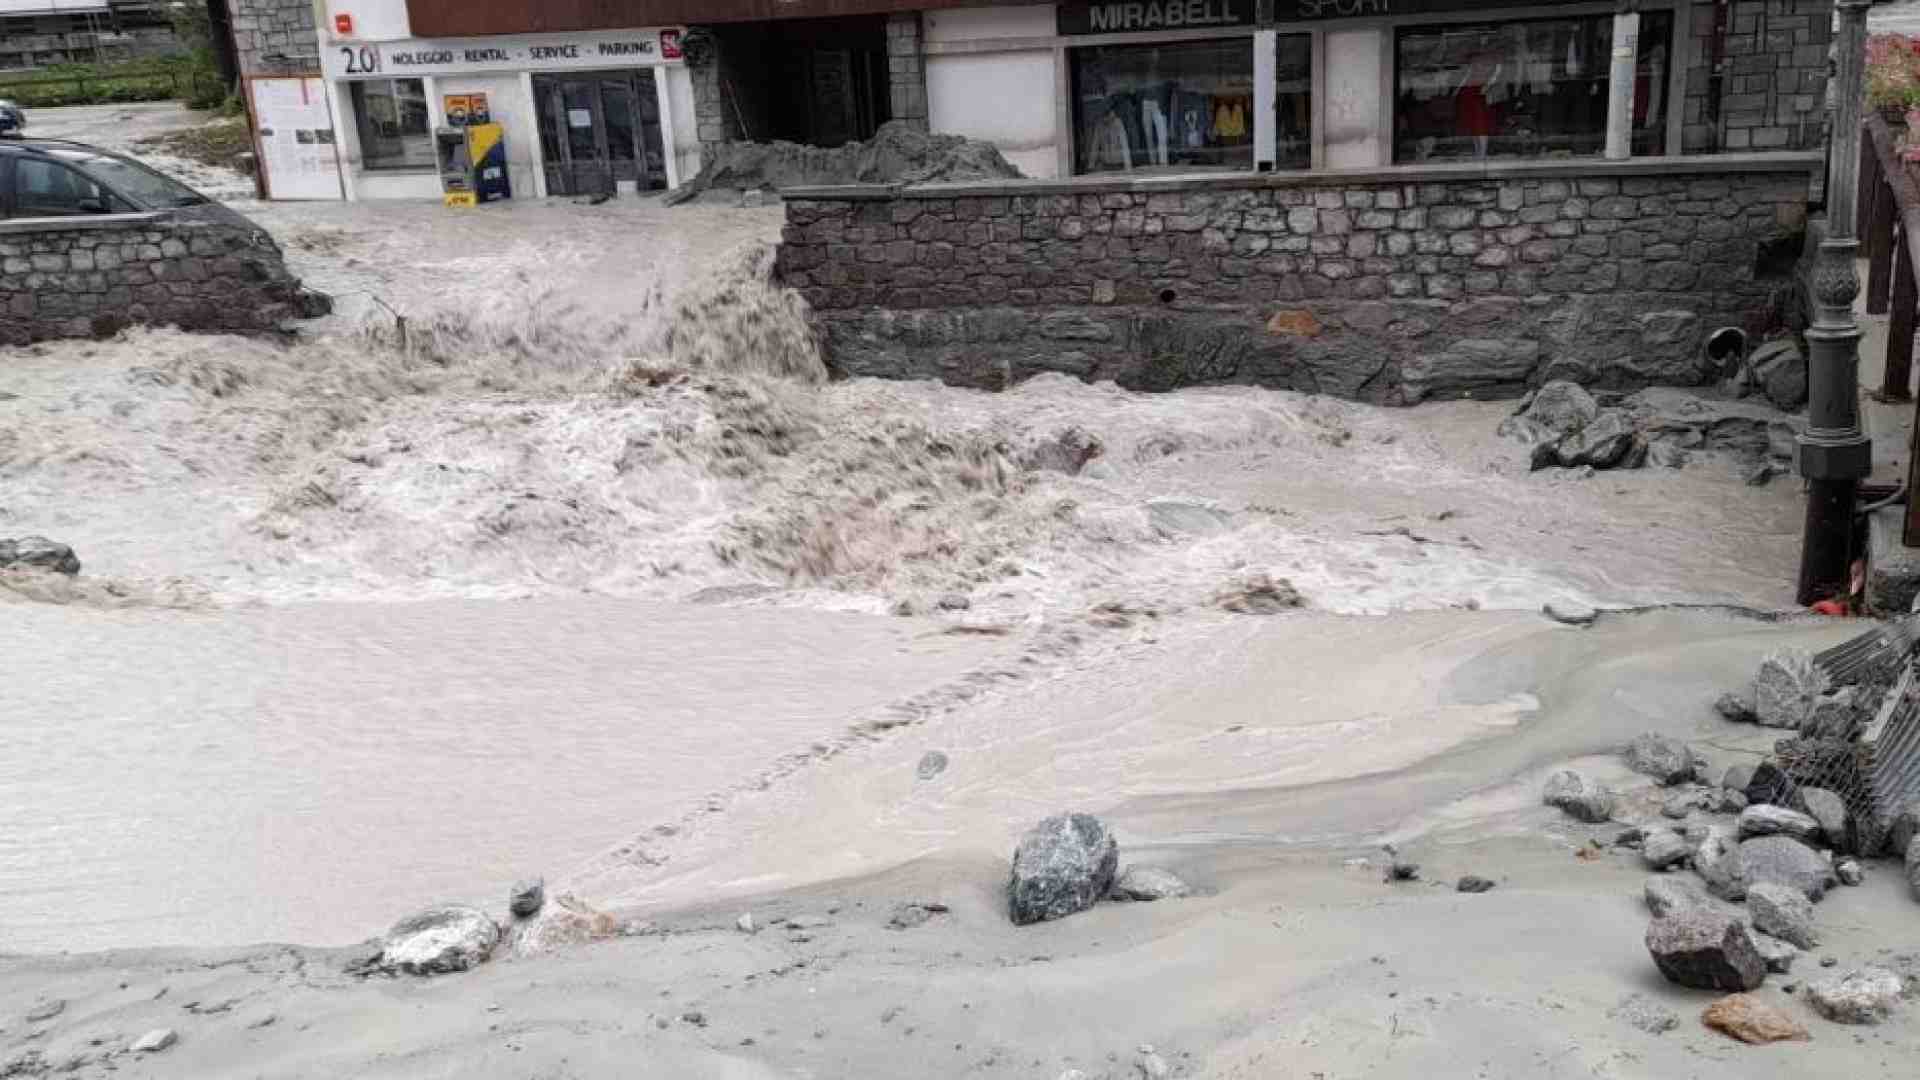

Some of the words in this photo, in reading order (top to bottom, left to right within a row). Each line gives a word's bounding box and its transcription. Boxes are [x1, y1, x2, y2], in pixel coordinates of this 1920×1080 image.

[1089, 0, 1239, 31] MIRABELL
[392, 49, 454, 65] NOLEGGIO
[464, 47, 511, 62] RENTAL
[529, 44, 580, 60] SERVICE
[598, 40, 654, 57] PARKING
